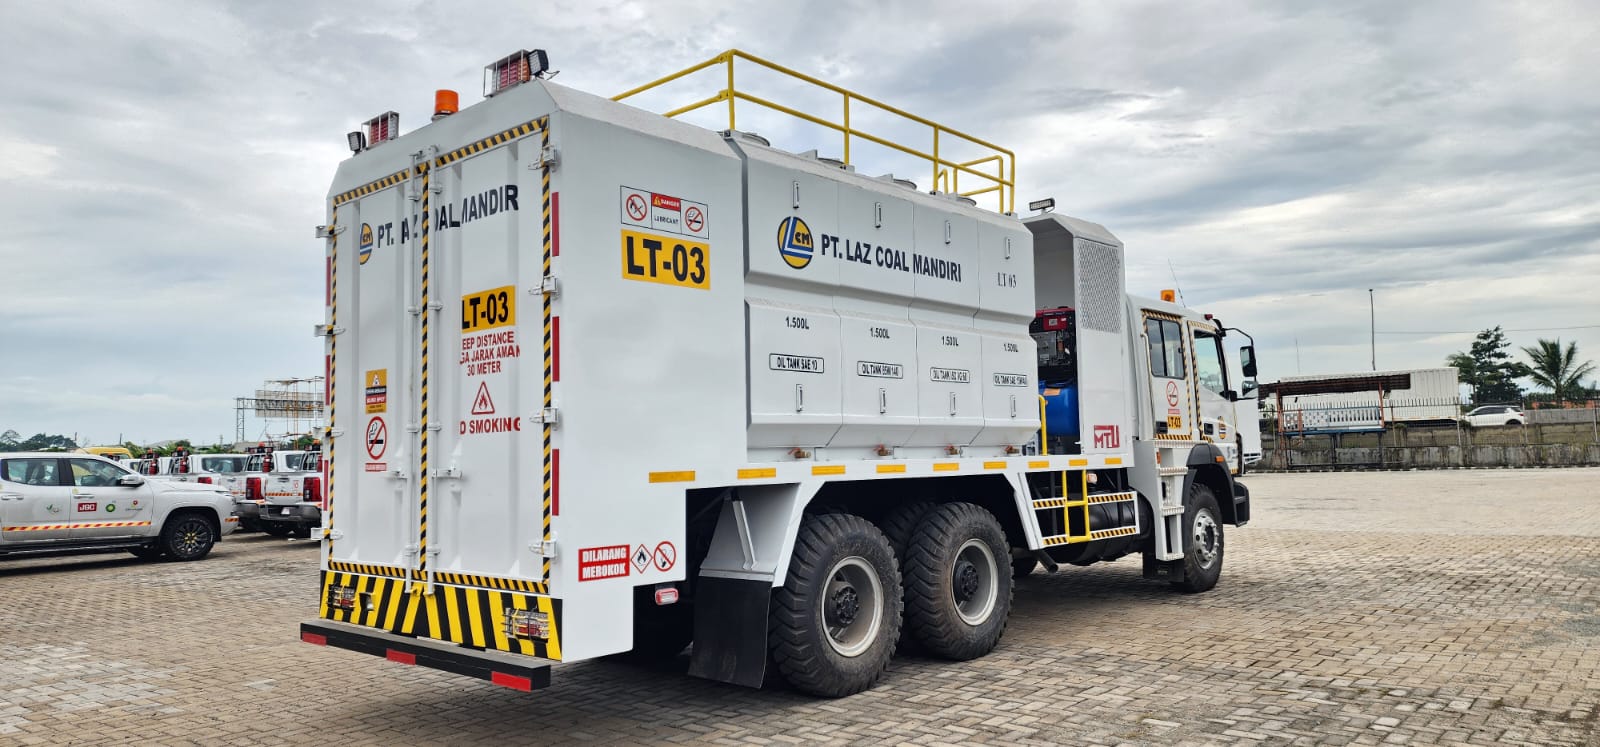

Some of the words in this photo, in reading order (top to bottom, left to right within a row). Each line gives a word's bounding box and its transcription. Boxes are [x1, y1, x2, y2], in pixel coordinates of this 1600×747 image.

[660, 199, 680, 208] DANGER
[378, 222, 394, 248] PT.
[461, 184, 519, 224] MANDIR
[654, 215, 679, 225] LUBRICANT
[626, 236, 705, 284] LT-03
[821, 233, 842, 259] PT.
[846, 239, 872, 265] LAZ
[875, 246, 910, 272] COAL
[913, 253, 962, 282] MANDIRI
[461, 291, 509, 330] LT-03
[785, 316, 810, 330] 1.500L
[462, 337, 475, 350] EEP
[476, 331, 514, 348] DISTANCE
[869, 327, 890, 339] 1.500L
[471, 348, 495, 362] JARAK
[777, 356, 786, 368] OIL
[786, 357, 800, 370] TANK
[801, 358, 811, 370] SAE
[467, 364, 475, 377] 30
[477, 360, 501, 375] METER
[870, 364, 882, 375] TANK
[469, 416, 521, 434] SMOKING
[582, 547, 627, 563] DILARANG
[582, 562, 626, 579] MEROKOK
